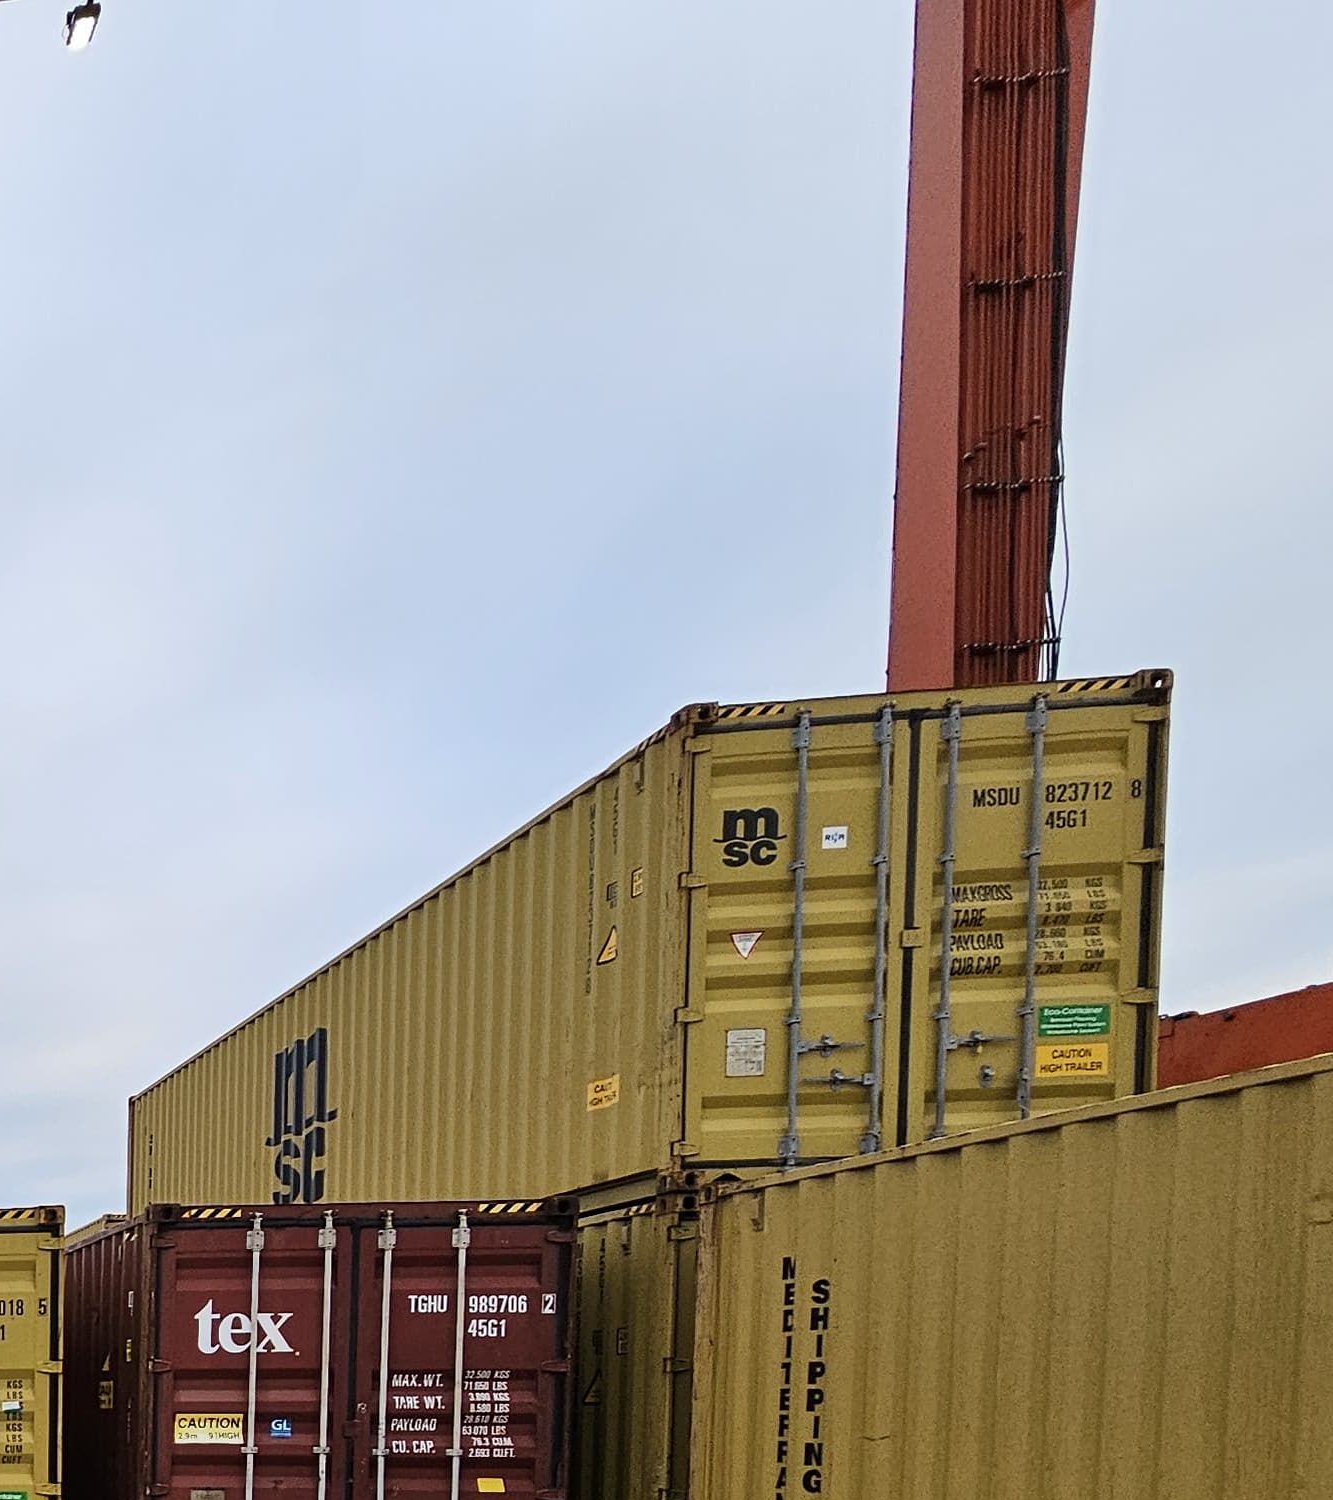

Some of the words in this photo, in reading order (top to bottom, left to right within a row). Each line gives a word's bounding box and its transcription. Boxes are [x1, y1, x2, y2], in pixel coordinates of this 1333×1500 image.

[973, 787, 1020, 807] MSDU
[1045, 781, 1113, 803] 823712
[1131, 780, 1141, 798] 8
[1045, 809, 1087, 829] 45G1
[953, 908, 986, 928] TARE
[950, 933, 1004, 951] PAYLOAD
[1052, 1048, 1092, 1059] CAUTION
[1039, 1064, 1062, 1073] HIGH
[1064, 1061, 1102, 1071] TRAILER
[38, 1298, 48, 1315] 5
[408, 1295, 448, 1313] TGHU
[468, 1295, 527, 1313] 989706
[543, 1294, 555, 1313] 2
[467, 1319, 506, 1337] 45G1
[6, 1380, 23, 1389] KGS
[801, 1279, 830, 1494] SHIPPING
[393, 1396, 420, 1409] TARE
[5, 1423, 23, 1432] KGS
[178, 1417, 241, 1429] CAUTION
[271, 1419, 291, 1431] GL
[391, 1418, 437, 1431] PAYLOAD
